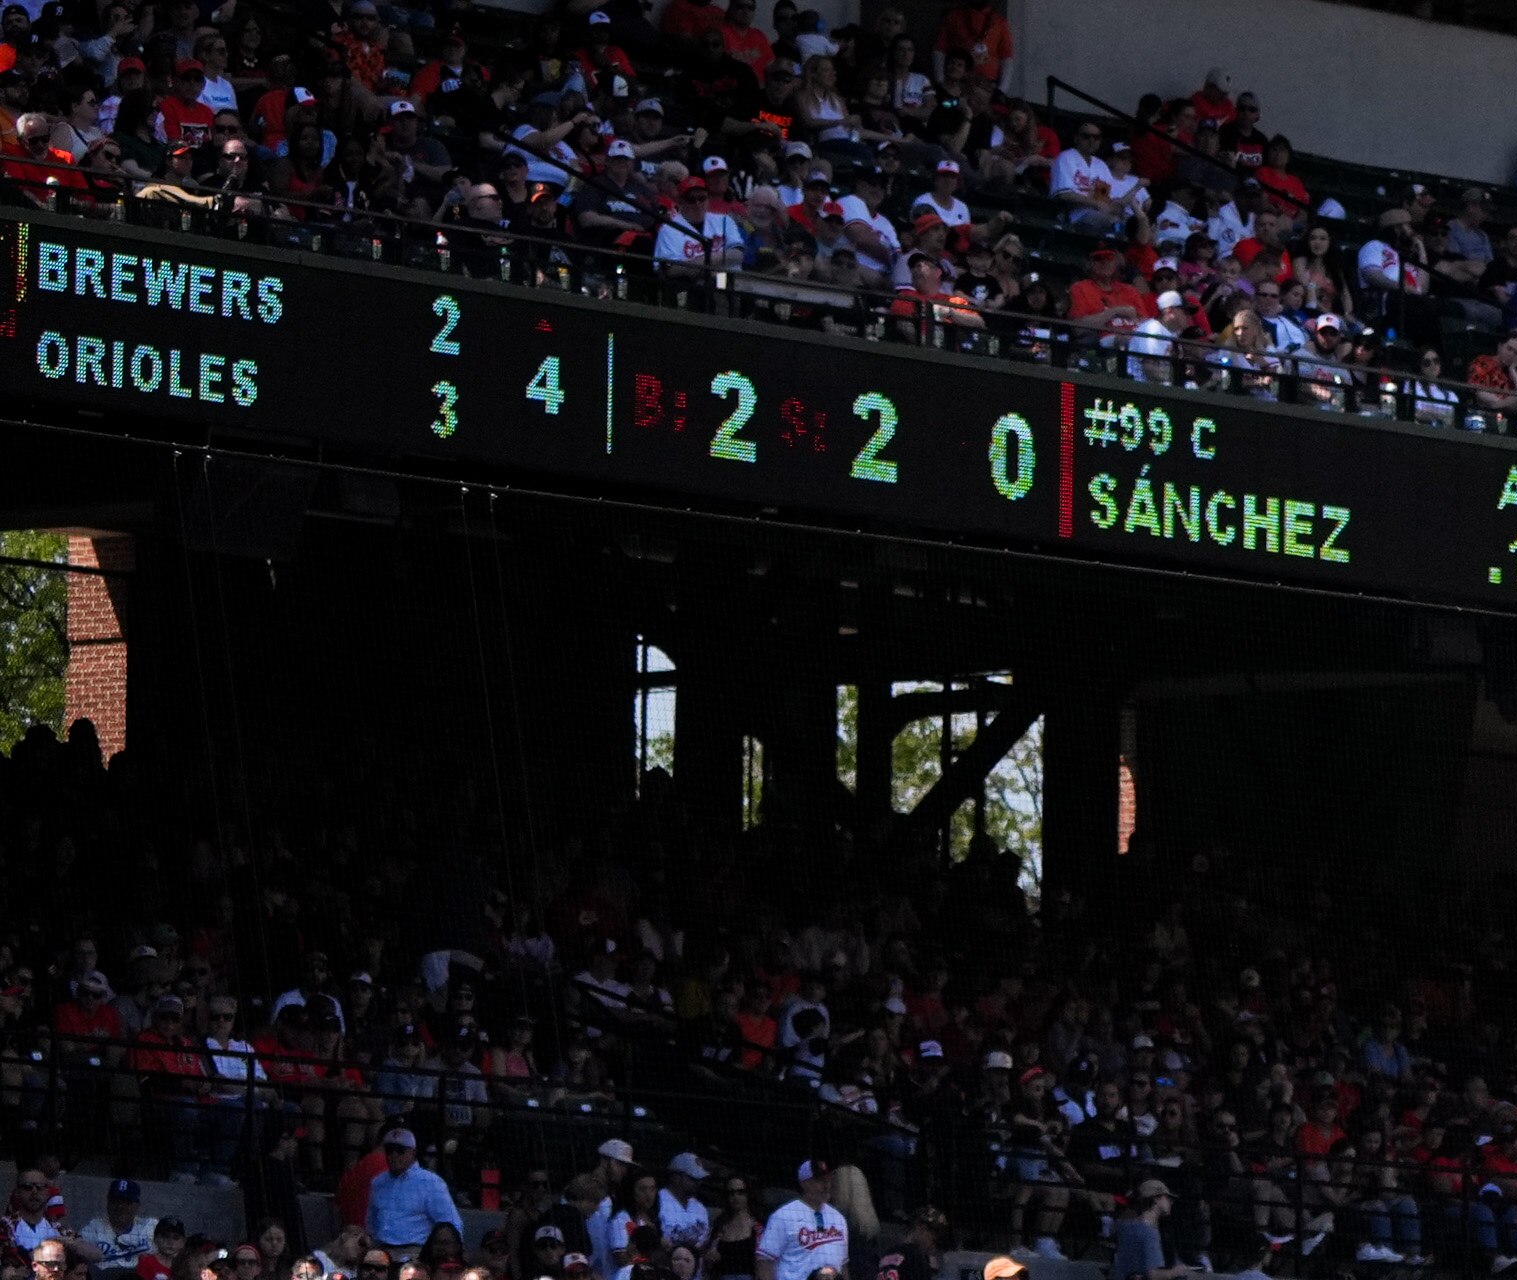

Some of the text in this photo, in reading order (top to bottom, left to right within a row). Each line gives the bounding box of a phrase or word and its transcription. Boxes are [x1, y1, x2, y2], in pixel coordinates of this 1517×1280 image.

[38, 241, 284, 324] BREWERS
[429, 295, 461, 355] 2
[36, 330, 459, 438] ORIOLES 3
[525, 356, 564, 415] 4
[710, 371, 757, 463] 2
[850, 391, 898, 483] 2
[988, 413, 1035, 500] 0
[1083, 398, 1216, 459] #99 C
[1088, 464, 1350, 563] SÁNCHEZ
